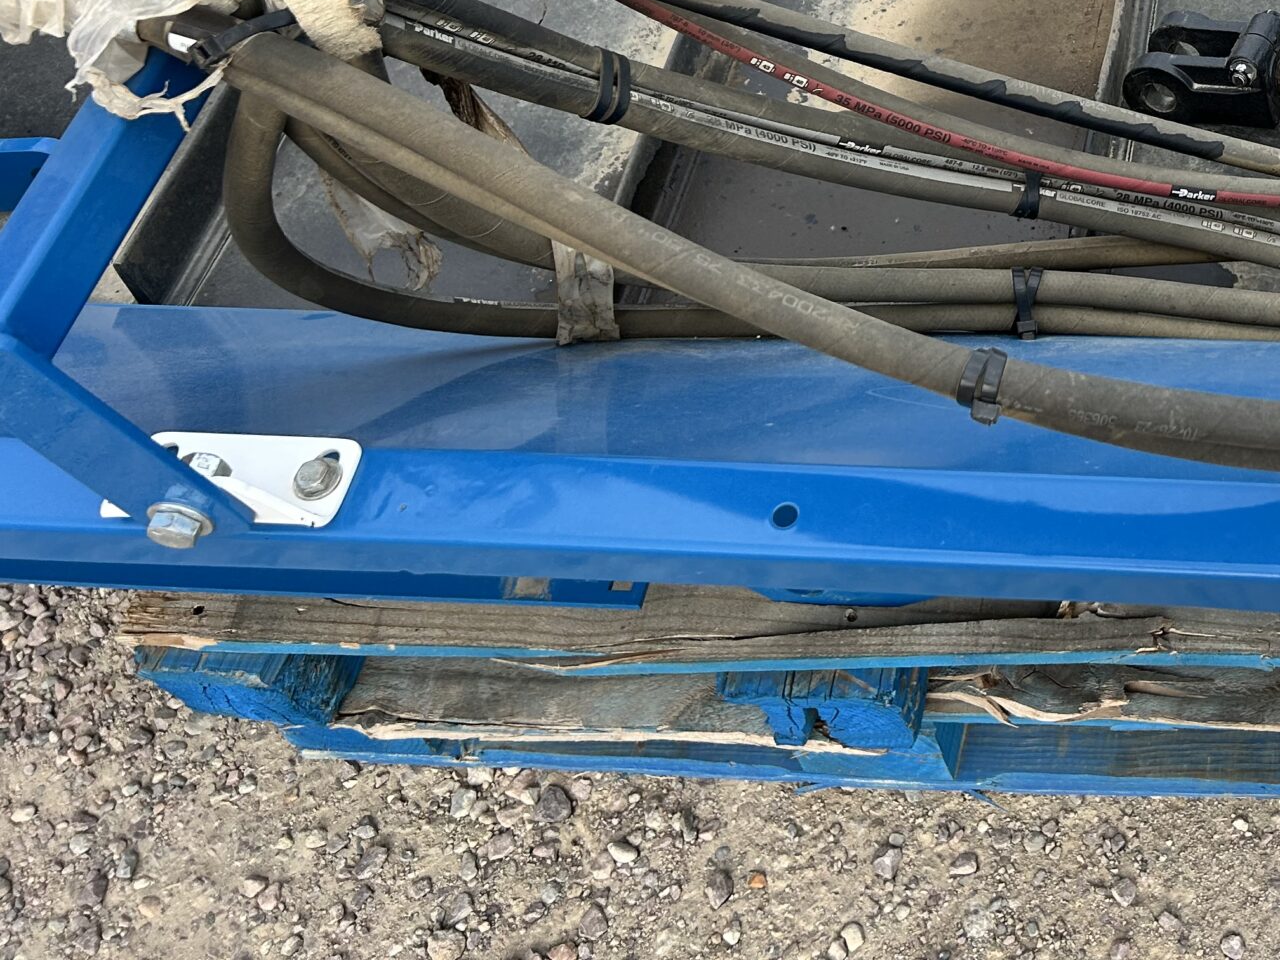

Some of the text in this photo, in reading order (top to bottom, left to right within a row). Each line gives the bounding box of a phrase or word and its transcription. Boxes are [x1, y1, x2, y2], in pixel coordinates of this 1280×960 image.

[407, 22, 455, 44] Parker
[834, 94, 952, 144] 35 MPa (5000 PSI)
[725, 119, 752, 136] MPa
[756, 127, 788, 145] (4000
[791, 137, 817, 153] PSI)
[839, 140, 882, 155] Parker
[1115, 191, 1131, 203] 28
[1133, 194, 1160, 209] MPa
[1162, 199, 1196, 216] (4000
[1199, 206, 1224, 220] PSI)
[1172, 188, 1215, 202] Parker
[1116, 206, 1130, 214] ISO
